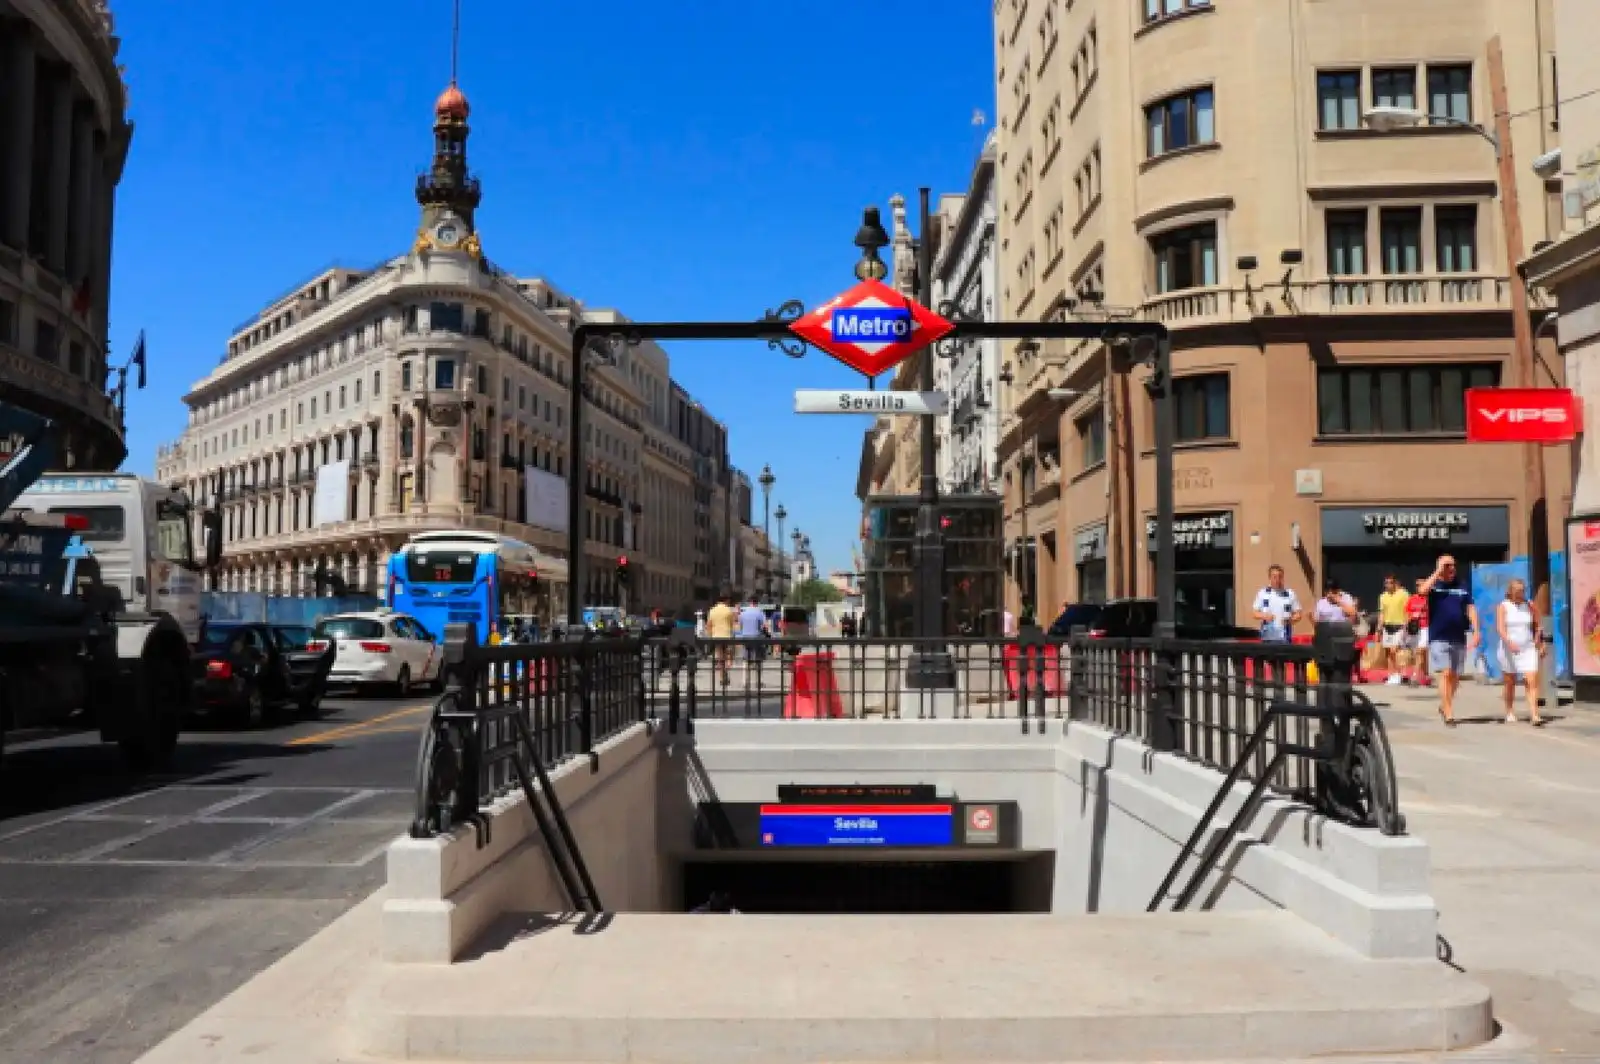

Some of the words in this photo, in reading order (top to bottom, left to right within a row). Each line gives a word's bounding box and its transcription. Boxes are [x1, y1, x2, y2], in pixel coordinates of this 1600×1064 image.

[837, 315, 908, 336] Metro
[839, 394, 904, 410] Sevilla
[1478, 408, 1567, 422] VIPS
[1363, 513, 1468, 526] STARBUCKS
[1382, 527, 1450, 539] COFFEE
